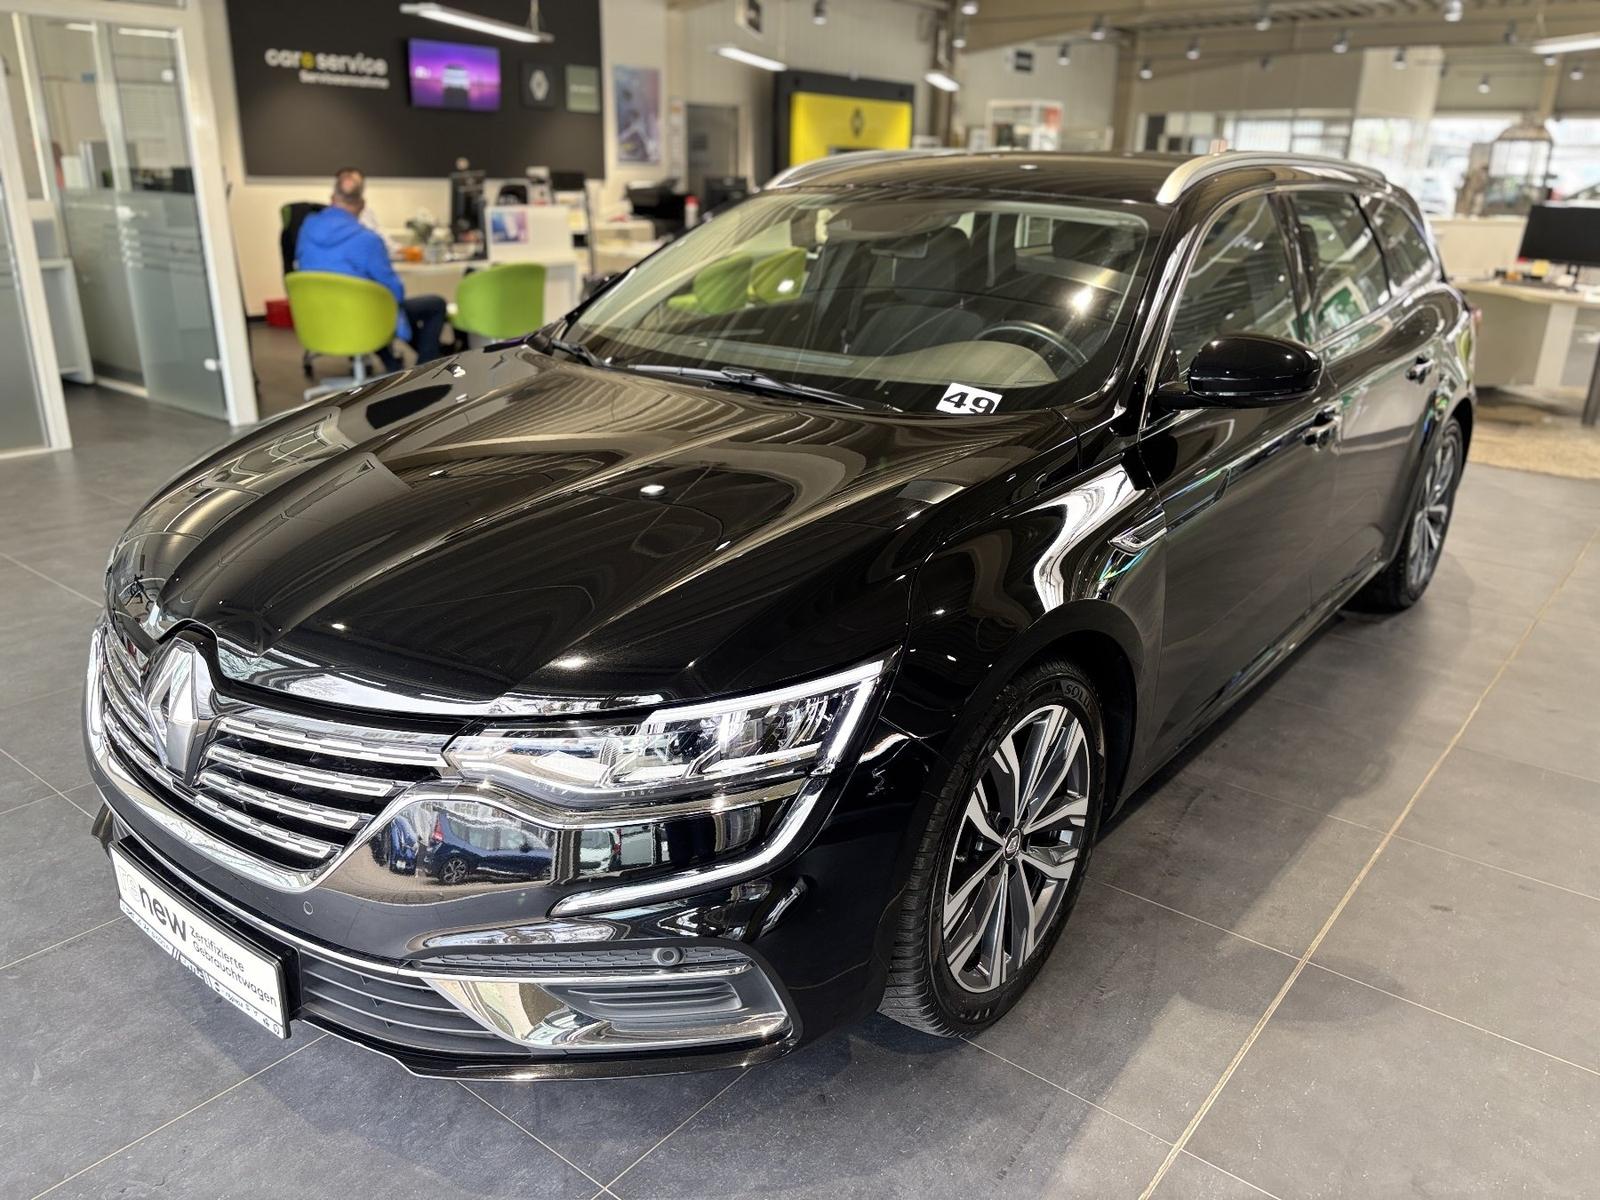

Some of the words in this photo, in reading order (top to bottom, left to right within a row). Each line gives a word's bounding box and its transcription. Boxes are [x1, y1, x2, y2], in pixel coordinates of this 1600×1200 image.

[316, 52, 388, 77] service
[943, 391, 996, 415] 49
[189, 925, 245, 973] Zertifizierte
[192, 940, 278, 1008] Gebrauchtwagen
